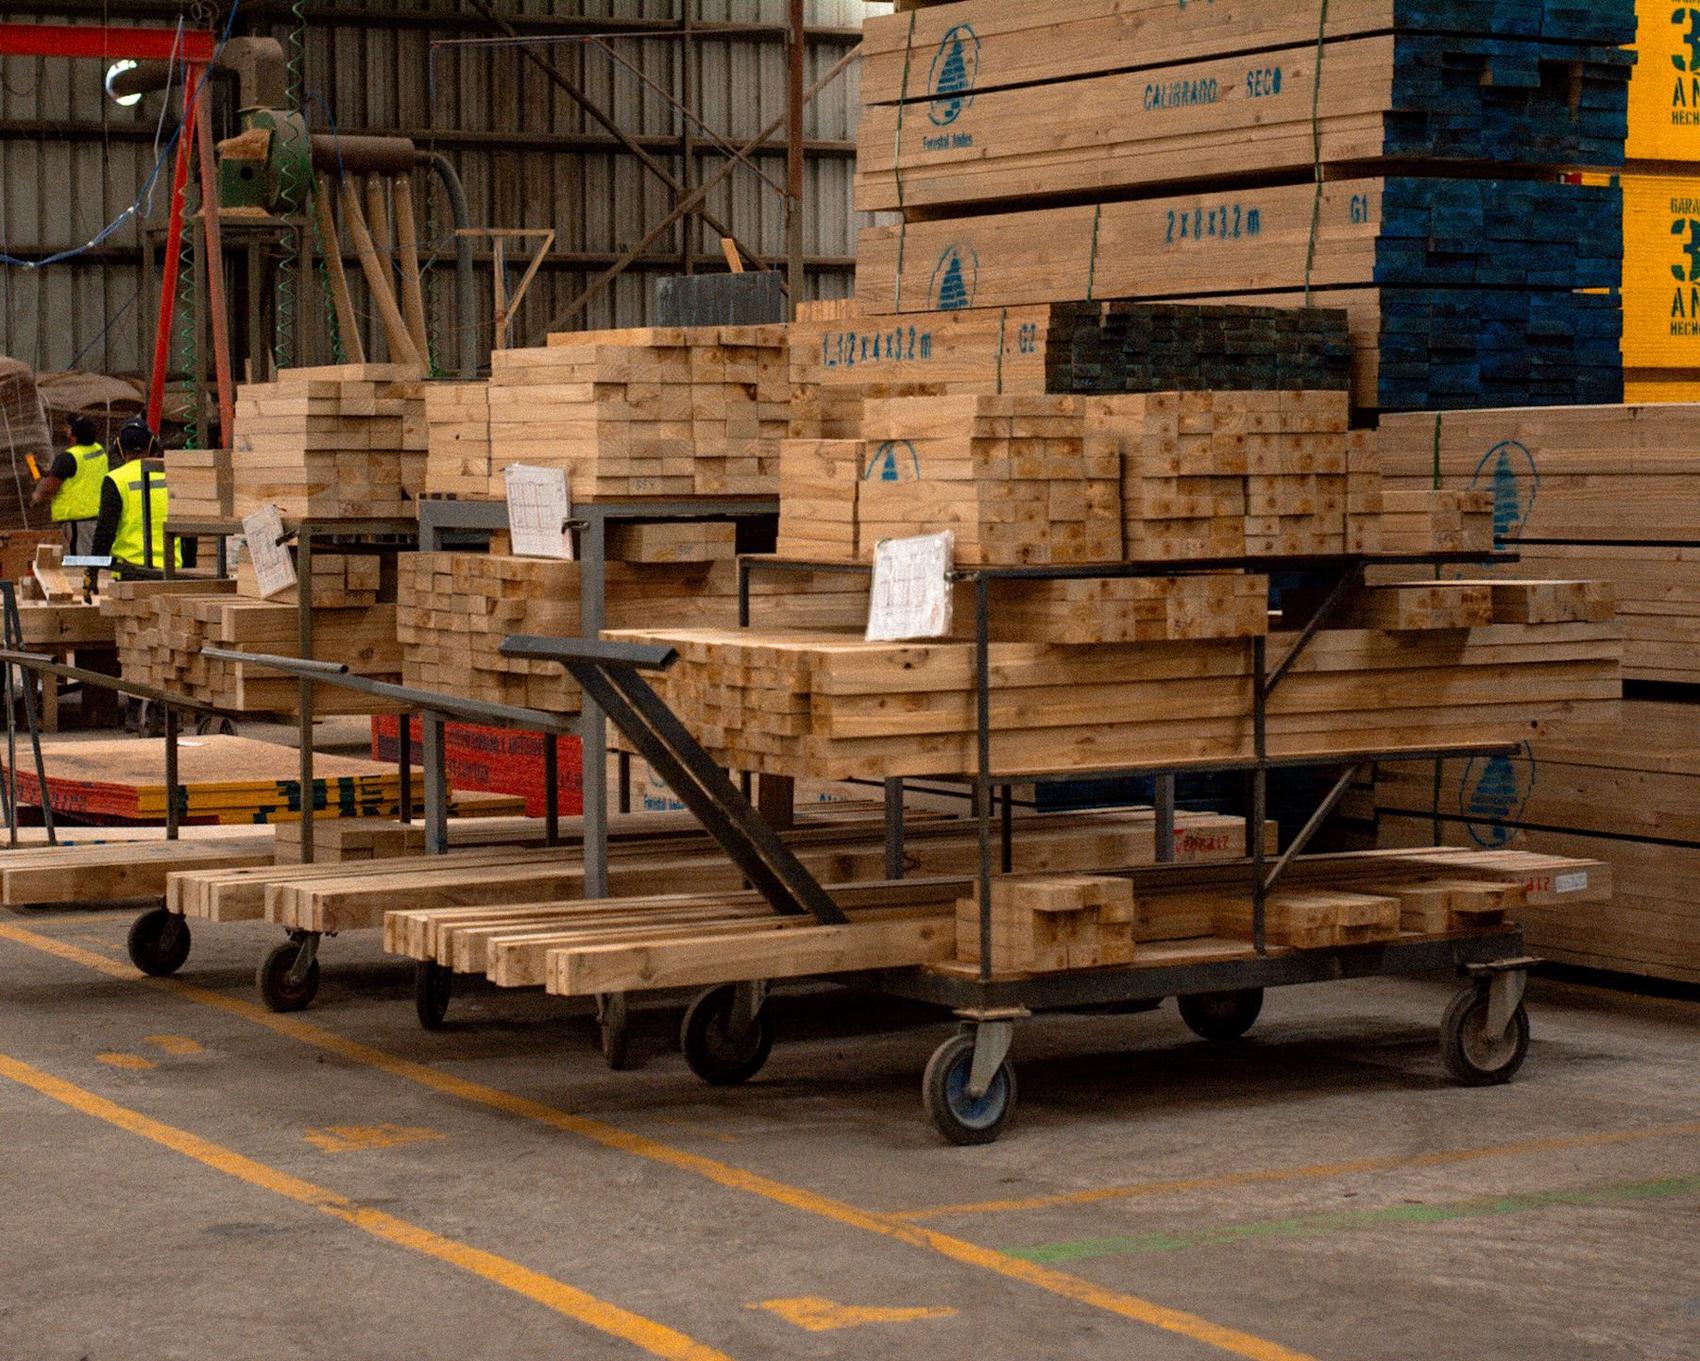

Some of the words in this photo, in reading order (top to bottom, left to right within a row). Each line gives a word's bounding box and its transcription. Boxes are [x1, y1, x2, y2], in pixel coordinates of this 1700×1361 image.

[1144, 79, 1217, 110] CALIBRADO
[1247, 66, 1282, 97] SECO
[1350, 194, 1368, 223] G1
